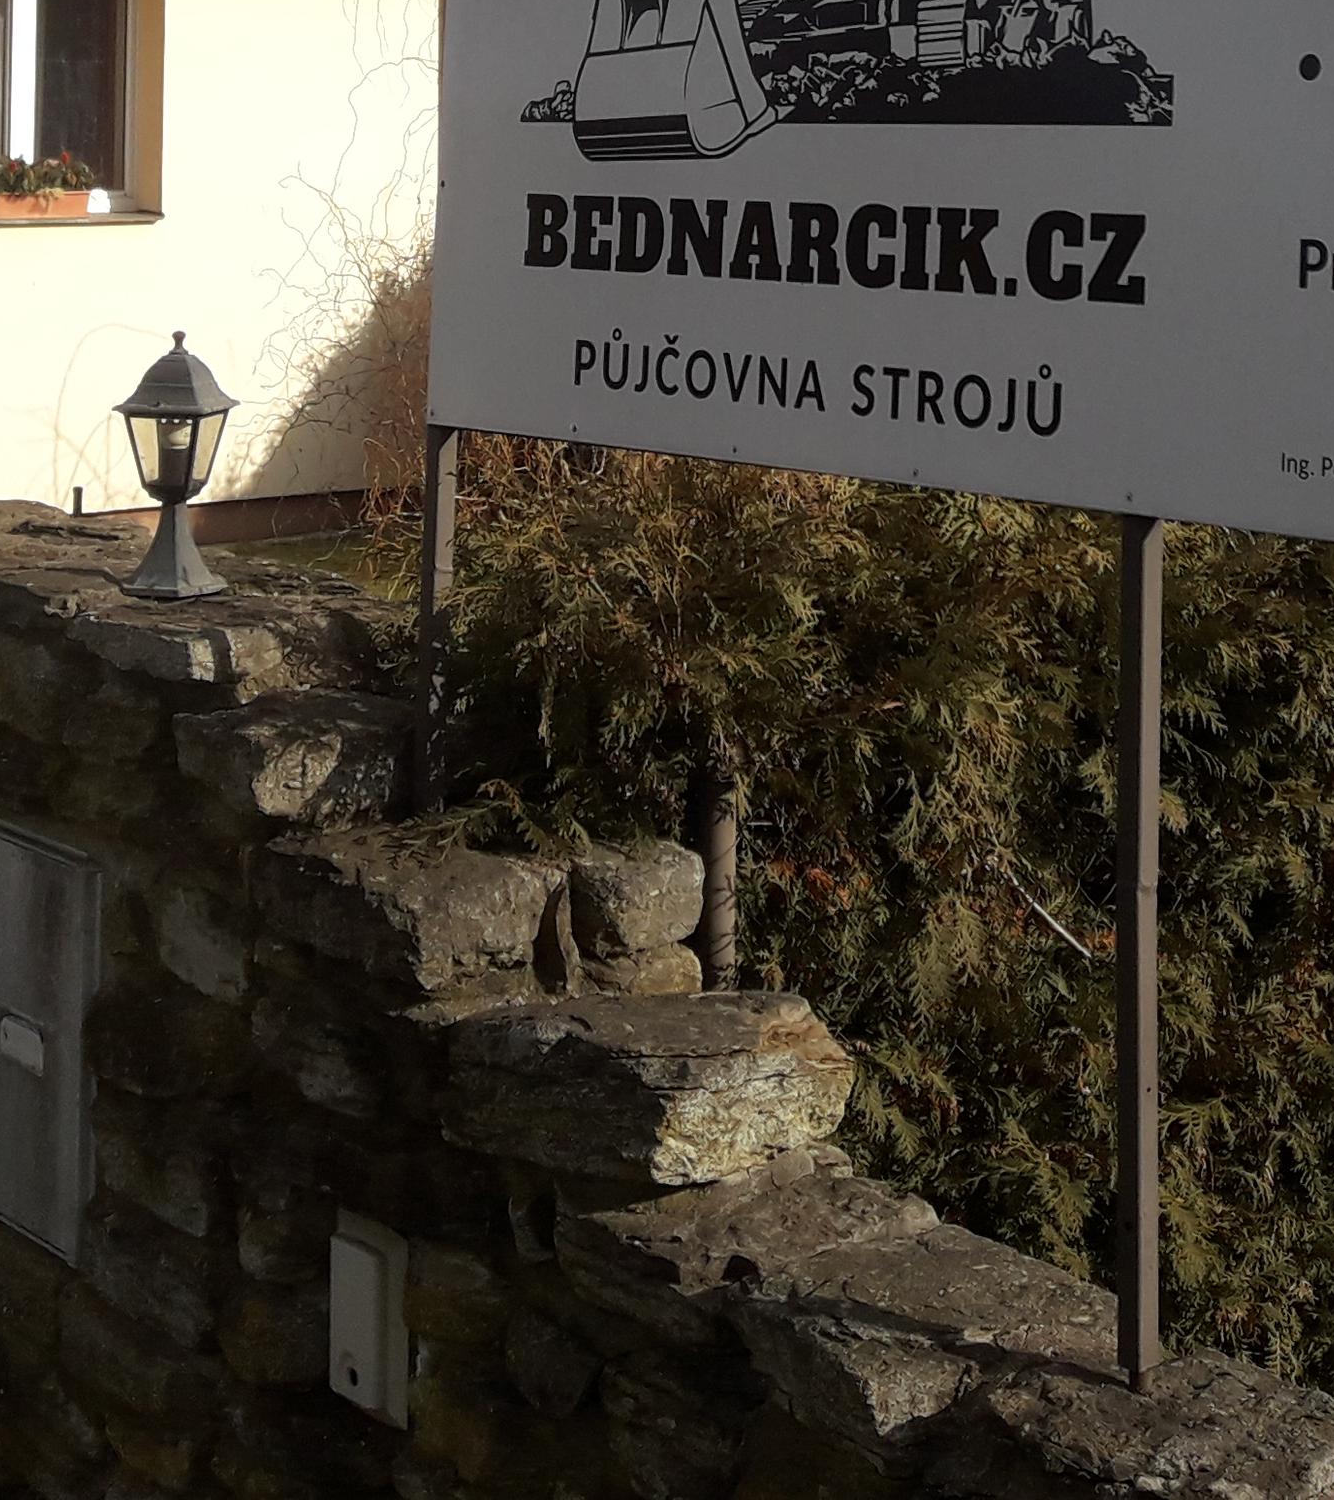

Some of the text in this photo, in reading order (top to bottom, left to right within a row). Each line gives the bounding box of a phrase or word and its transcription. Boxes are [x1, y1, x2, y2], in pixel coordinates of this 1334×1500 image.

[523, 192, 1147, 306] BEDNARCIK.CZ
[573, 327, 1063, 438] PŮJČOVNA STROJŮ
[1280, 451, 1315, 481] Ing.
